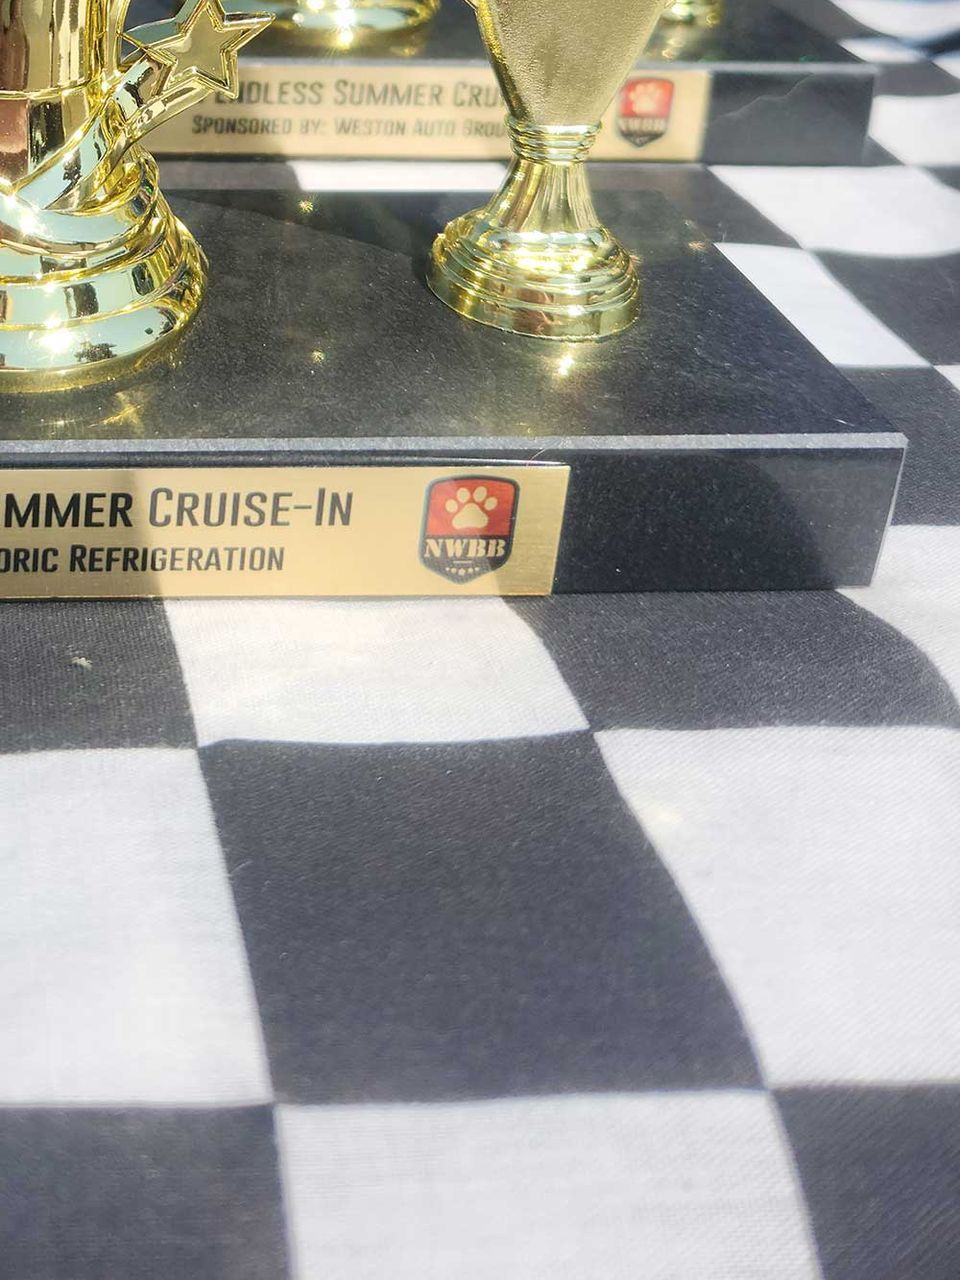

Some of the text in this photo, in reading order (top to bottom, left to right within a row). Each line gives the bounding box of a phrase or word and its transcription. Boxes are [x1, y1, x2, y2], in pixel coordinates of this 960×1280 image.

[333, 79, 444, 107] SUMMER
[453, 81, 504, 108] CRU
[192, 115, 293, 135] SPONSORED
[335, 119, 407, 136] WESTON
[414, 117, 455, 137] AUTO
[148, 487, 354, 527] CRUISE-IN
[69, 543, 285, 573] REFRIGERATION
[423, 537, 507, 558] NWBB
